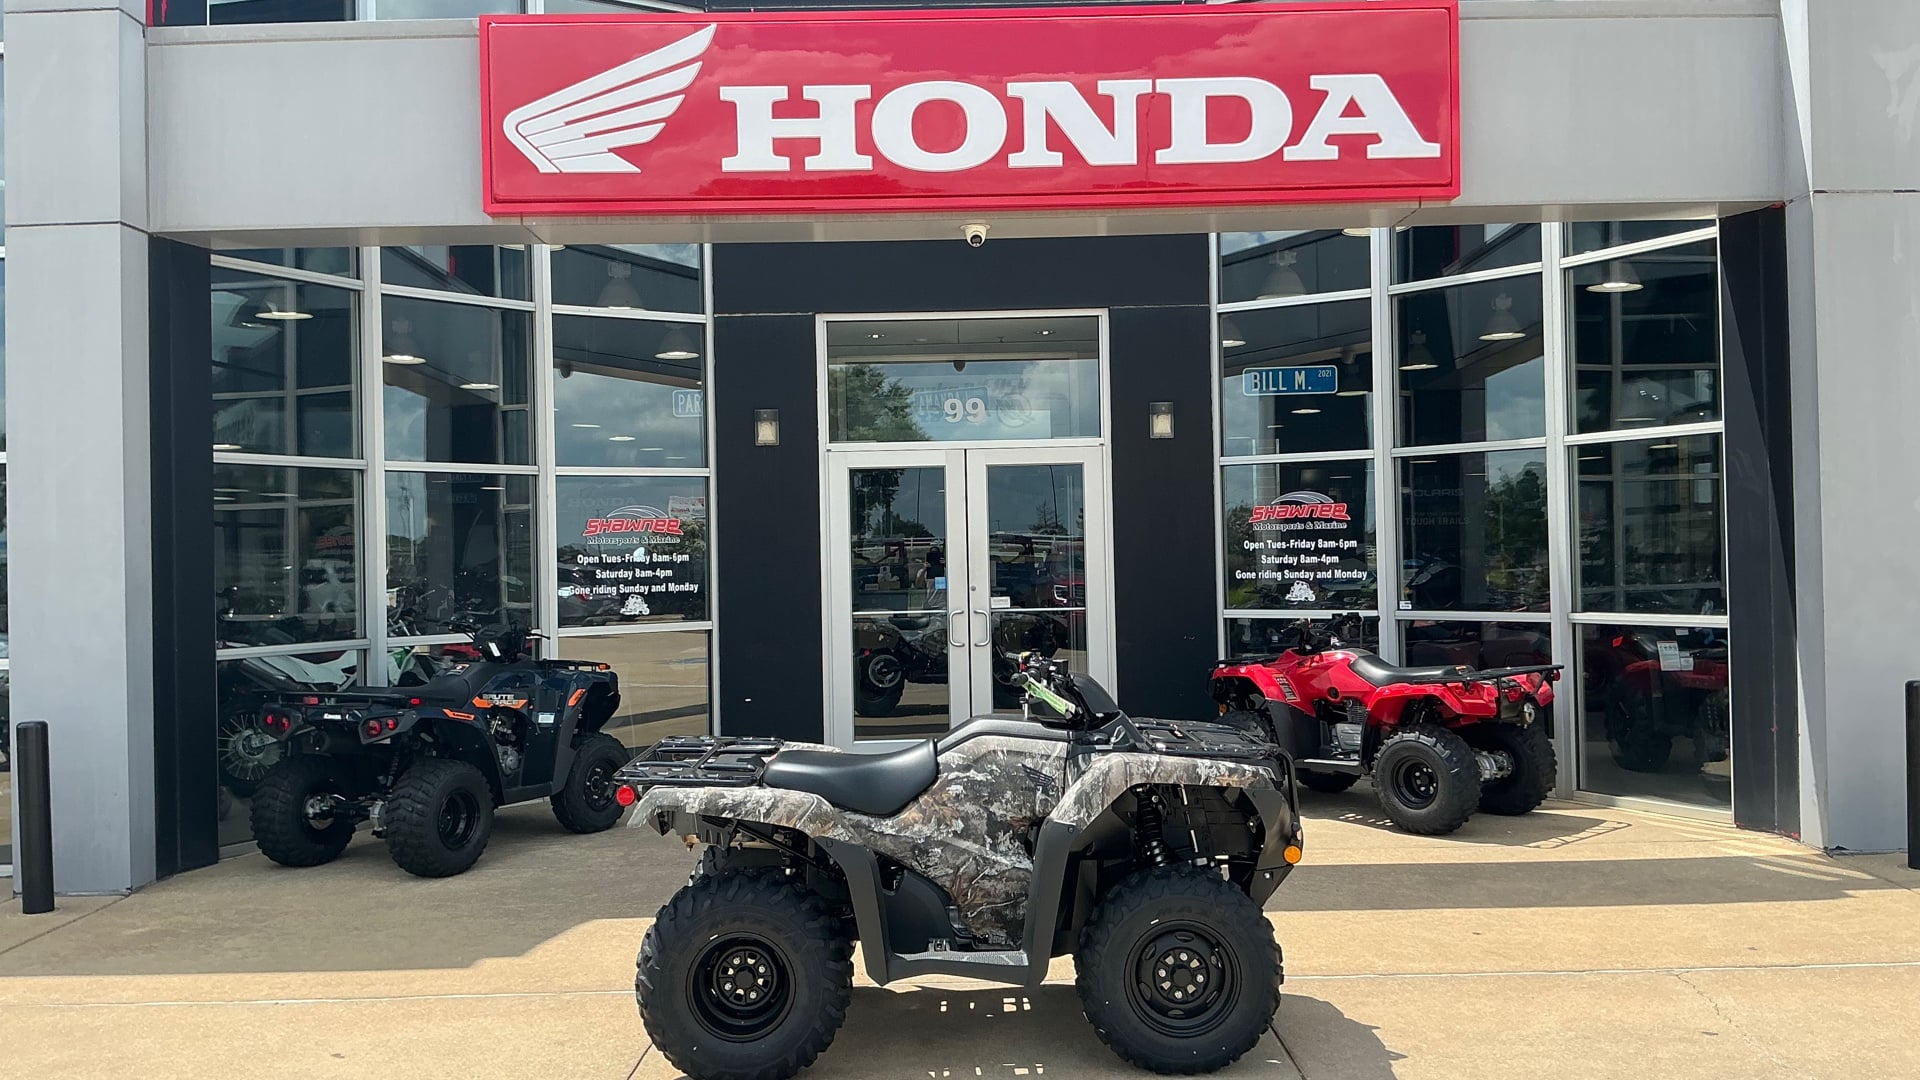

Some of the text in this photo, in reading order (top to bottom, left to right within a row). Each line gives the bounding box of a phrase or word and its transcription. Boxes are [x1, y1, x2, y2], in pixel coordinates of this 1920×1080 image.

[720, 73, 1441, 173] HONDA
[1318, 369, 1332, 378] 2021
[1251, 370, 1312, 392] BILL M.
[678, 393, 704, 414] PAR
[944, 398, 986, 423] 99
[1252, 521, 1347, 532] Motorsports & Marine
[586, 536, 640, 546] Motorsports
[650, 536, 681, 544] Marine
[1243, 538, 1358, 551] Open Tues-Friday 8am-6pm
[577, 553, 690, 566] Open Tues-Friay 8am-6pm
[1261, 553, 1339, 566] Saturday 8am-4pm
[595, 568, 673, 580] Saturday 8am-4pm
[1235, 569, 1368, 581] Gone riding Sunday and Monday
[569, 582, 699, 596] Gone riding Sunday and Monday
